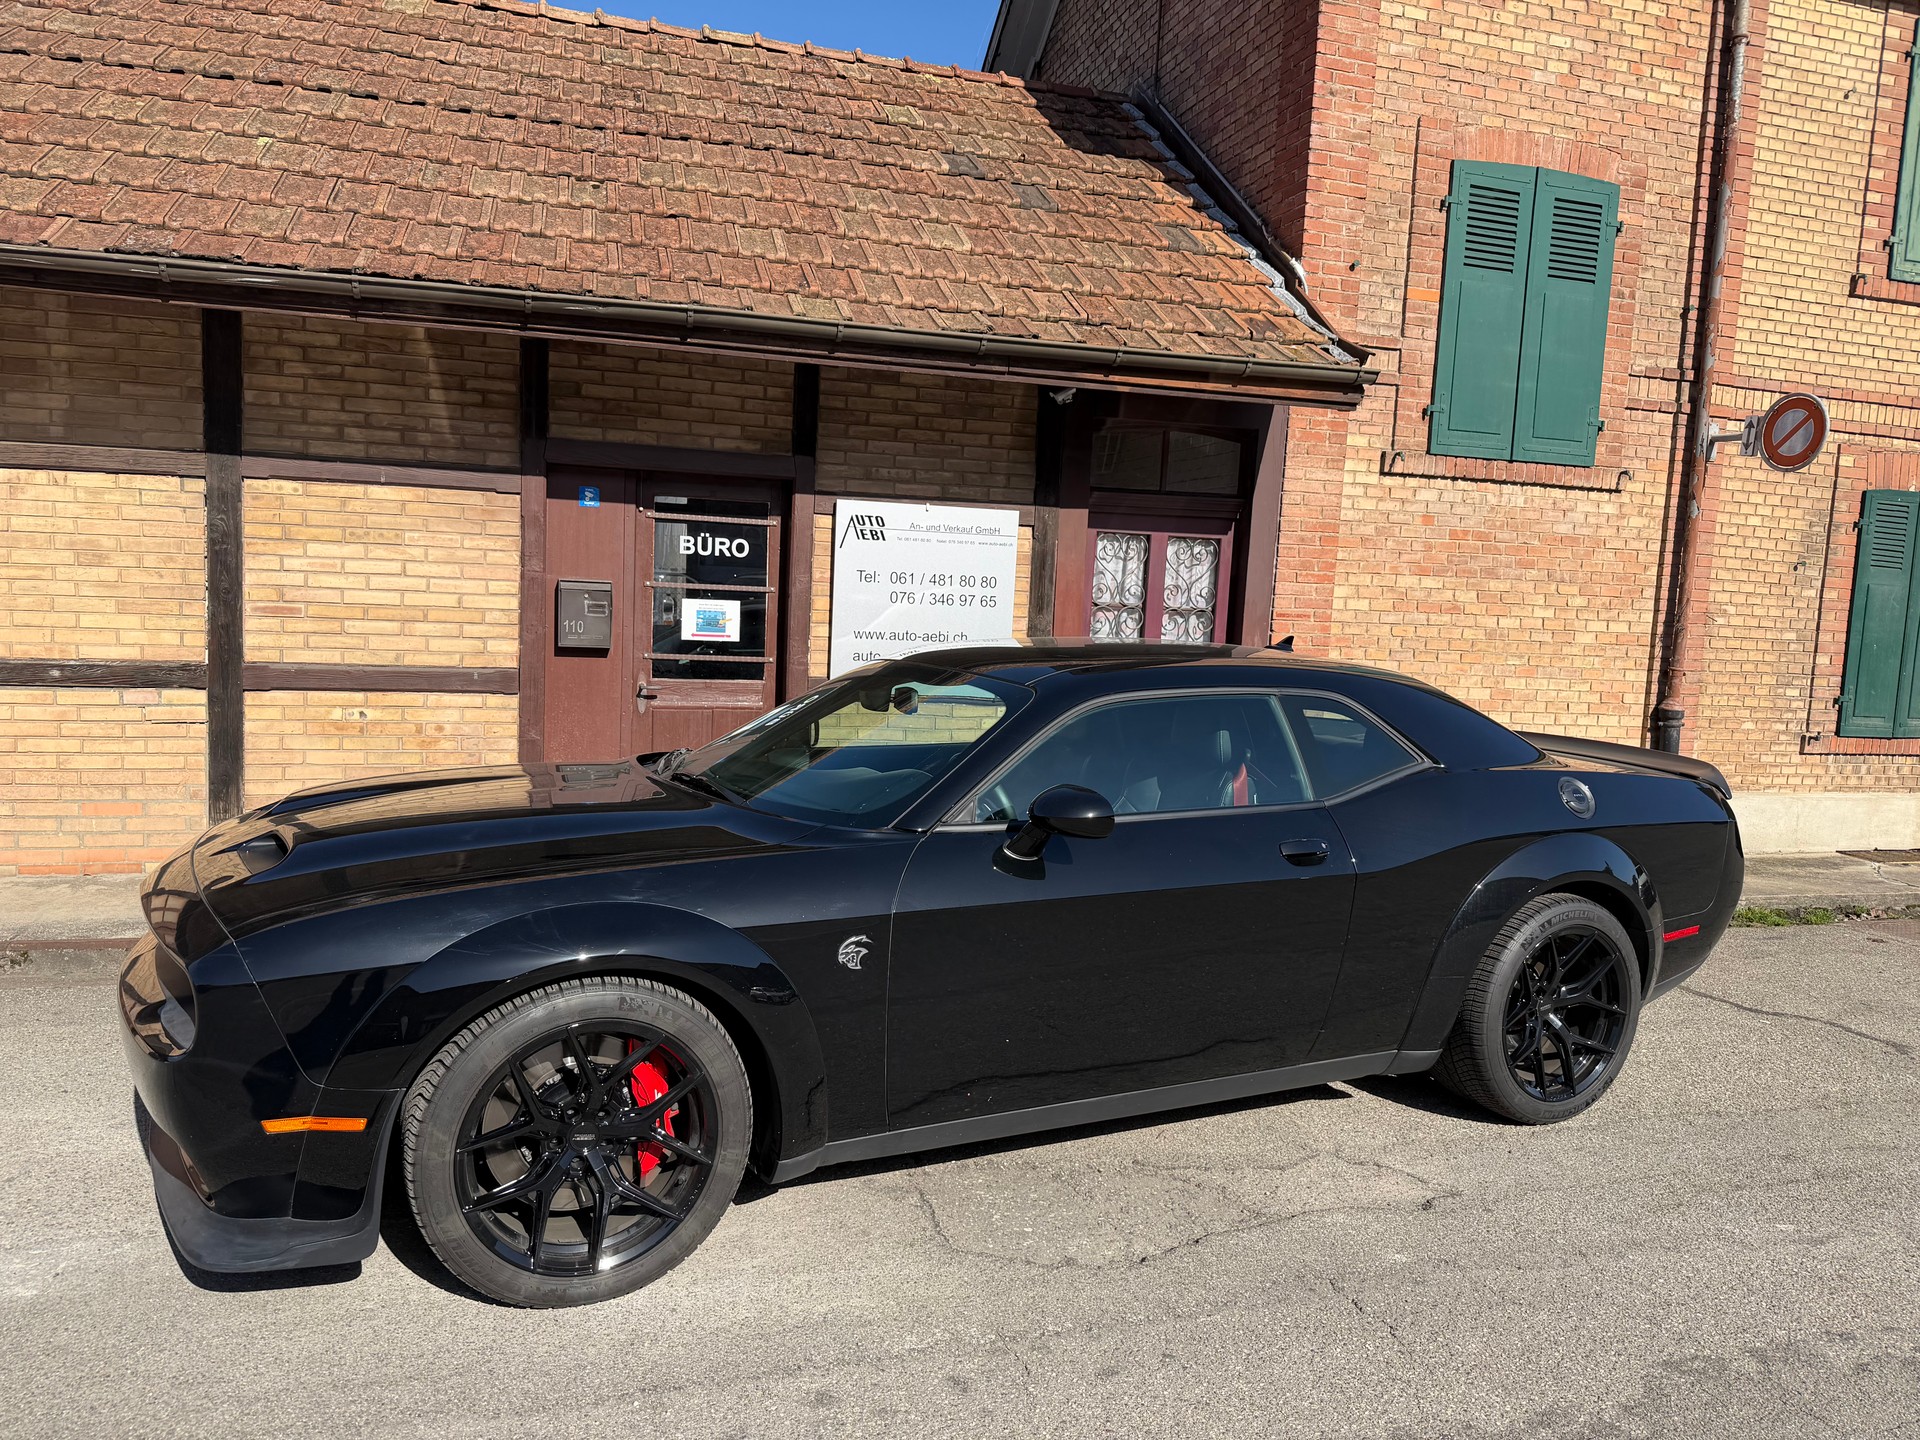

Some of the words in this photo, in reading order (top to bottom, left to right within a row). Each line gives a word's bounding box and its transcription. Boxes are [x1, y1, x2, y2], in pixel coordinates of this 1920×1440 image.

[909, 522, 924, 531] An-
[926, 524, 941, 532] und
[943, 524, 974, 534] Verkauf
[975, 526, 1001, 535] GmbH
[680, 532, 749, 558] BÜRO
[856, 569, 881, 583] Tel:
[890, 571, 915, 585] 061
[919, 572, 926, 585] /
[928, 573, 954, 587] 481
[959, 574, 976, 588] 80
[980, 575, 997, 589] 80
[889, 590, 916, 605] 076
[919, 592, 926, 605] /
[928, 592, 955, 606] 346
[959, 593, 976, 607] 97
[980, 595, 997, 608] 65
[563, 619, 584, 633] 110
